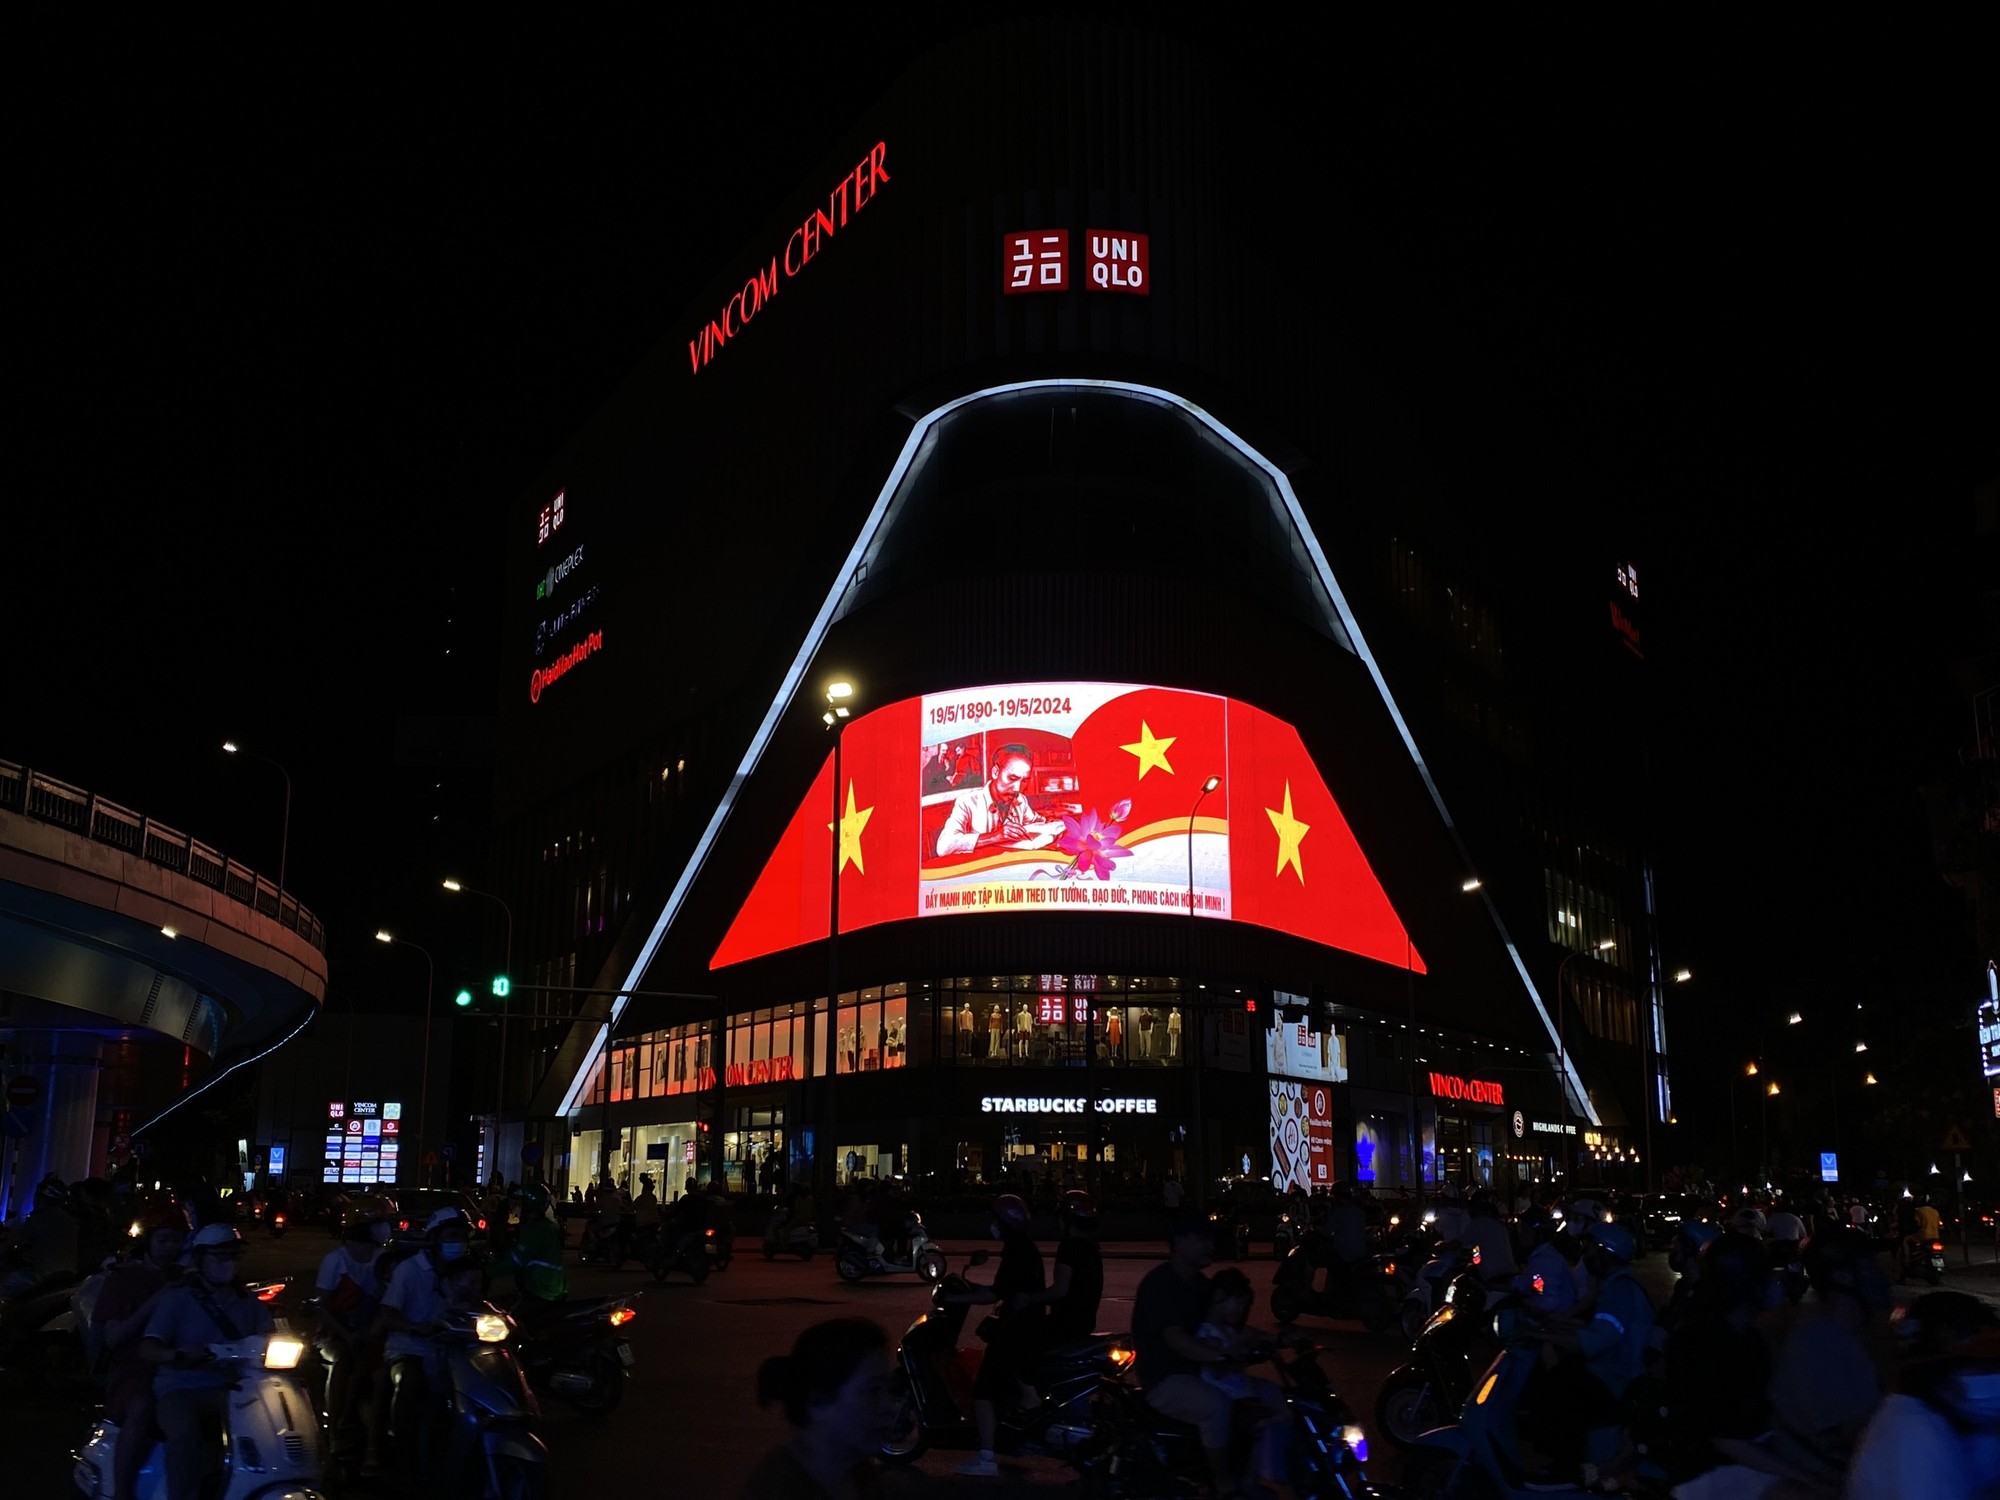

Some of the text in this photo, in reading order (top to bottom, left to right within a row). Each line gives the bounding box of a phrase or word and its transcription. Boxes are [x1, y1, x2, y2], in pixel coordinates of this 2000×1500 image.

[690, 141, 890, 375] VINCOM CENTER
[1093, 237, 1137, 262] UNI
[1093, 262, 1142, 288] QLO
[930, 697, 1072, 725] 19/5/1890-19/5/2024
[994, 886, 1005, 904] VÀ
[1006, 885, 1024, 903] LÀM
[1026, 887, 1046, 903] THEO
[1131, 889, 1158, 905] PHONG
[1204, 895, 1222, 911] MINH
[698, 1056, 794, 1091] VINOM CENTER
[981, 1096, 1087, 1113] STARBUCKS
[1470, 1079, 1504, 1105] CENTER
[1560, 1124, 1577, 1135] CFFEE
